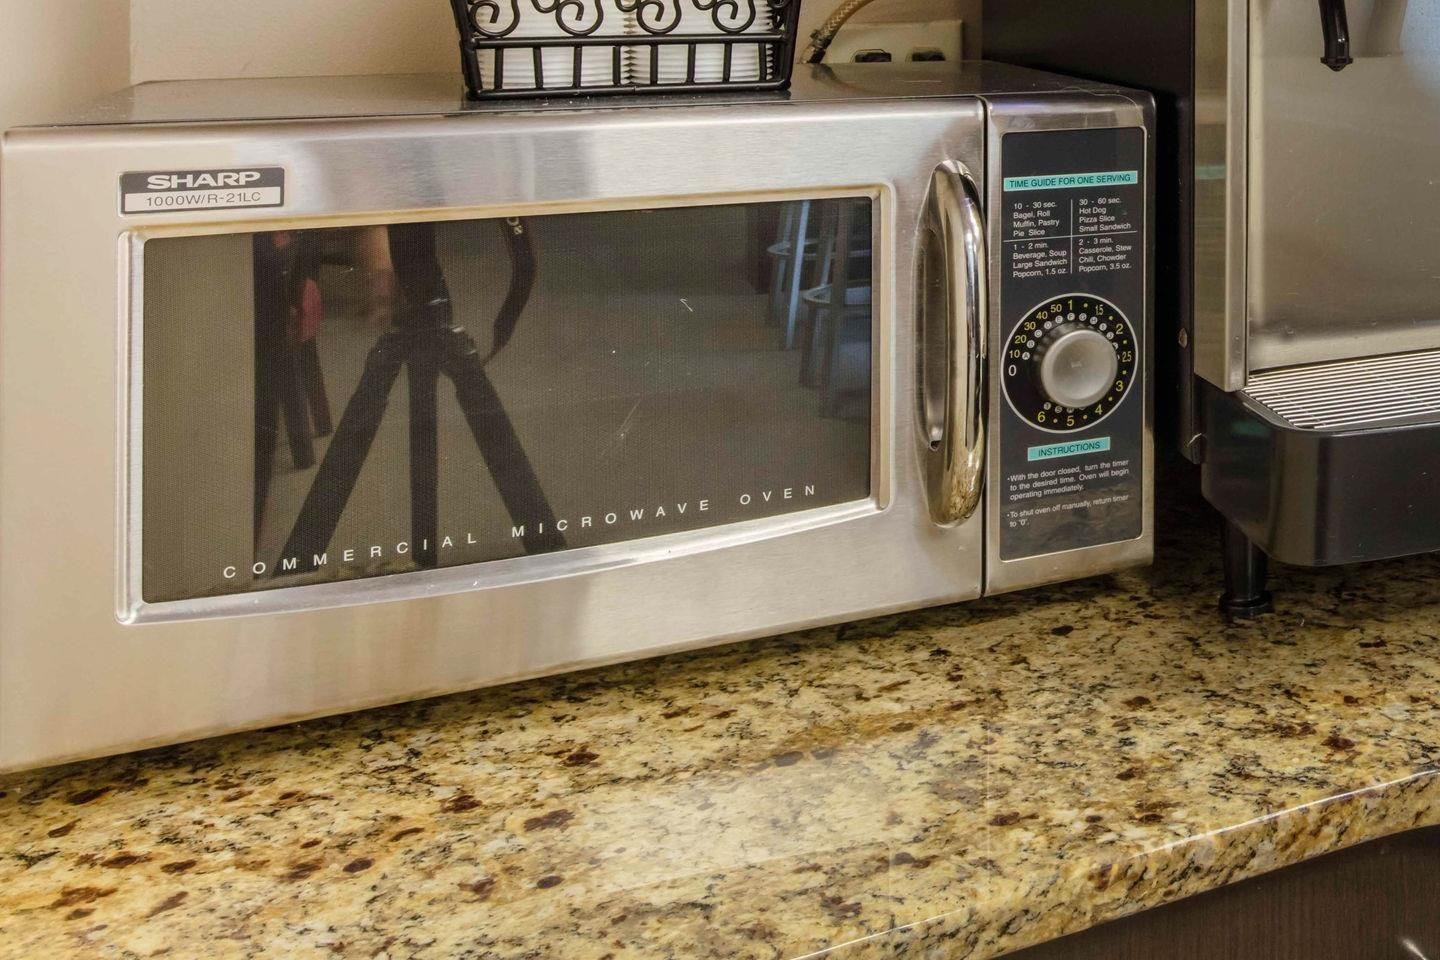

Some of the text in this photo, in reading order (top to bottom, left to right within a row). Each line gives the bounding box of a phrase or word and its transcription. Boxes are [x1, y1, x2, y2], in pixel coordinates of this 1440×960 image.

[147, 172, 261, 189] SHARP
[1010, 180, 1028, 188] TIME
[1031, 178, 1056, 186] GUIDE
[1077, 176, 1094, 184] ONE
[1096, 174, 1130, 182] SERVING
[147, 192, 261, 207] 1000W/R-21LC
[1100, 223, 1131, 231] Sandwich
[1013, 252, 1047, 260] Beverage,
[1079, 246, 1114, 255] Casserole,
[1013, 258, 1067, 269] Large Sandwich
[1097, 254, 1126, 262] Chowder
[1013, 270, 1043, 278] Popcorn,
[1051, 304, 1062, 312] 50
[1067, 300, 1073, 310] 1
[1036, 311, 1048, 320] 40
[1024, 322, 1036, 330] 30
[1116, 324, 1124, 335] 2
[1015, 335, 1027, 344] 20
[1009, 350, 1020, 358] 10
[1008, 365, 1016, 376] 0
[1116, 380, 1123, 392] 3
[1095, 404, 1103, 415] 4
[1038, 412, 1045, 422] 6
[1066, 415, 1075, 427] 5
[1038, 442, 1100, 456] INSTRUCTIONS
[1032, 479, 1058, 488] desired
[1079, 473, 1096, 481] Oven
[1111, 468, 1129, 477] begin
[1010, 484, 1084, 501] operating immediately.
[1035, 506, 1051, 515] oven
[1052, 504, 1061, 512] off
[1062, 500, 1092, 510] manually,
[1093, 497, 1111, 505] return
[222, 484, 817, 580] COMMERCIAL MICROWAVE OVEN
